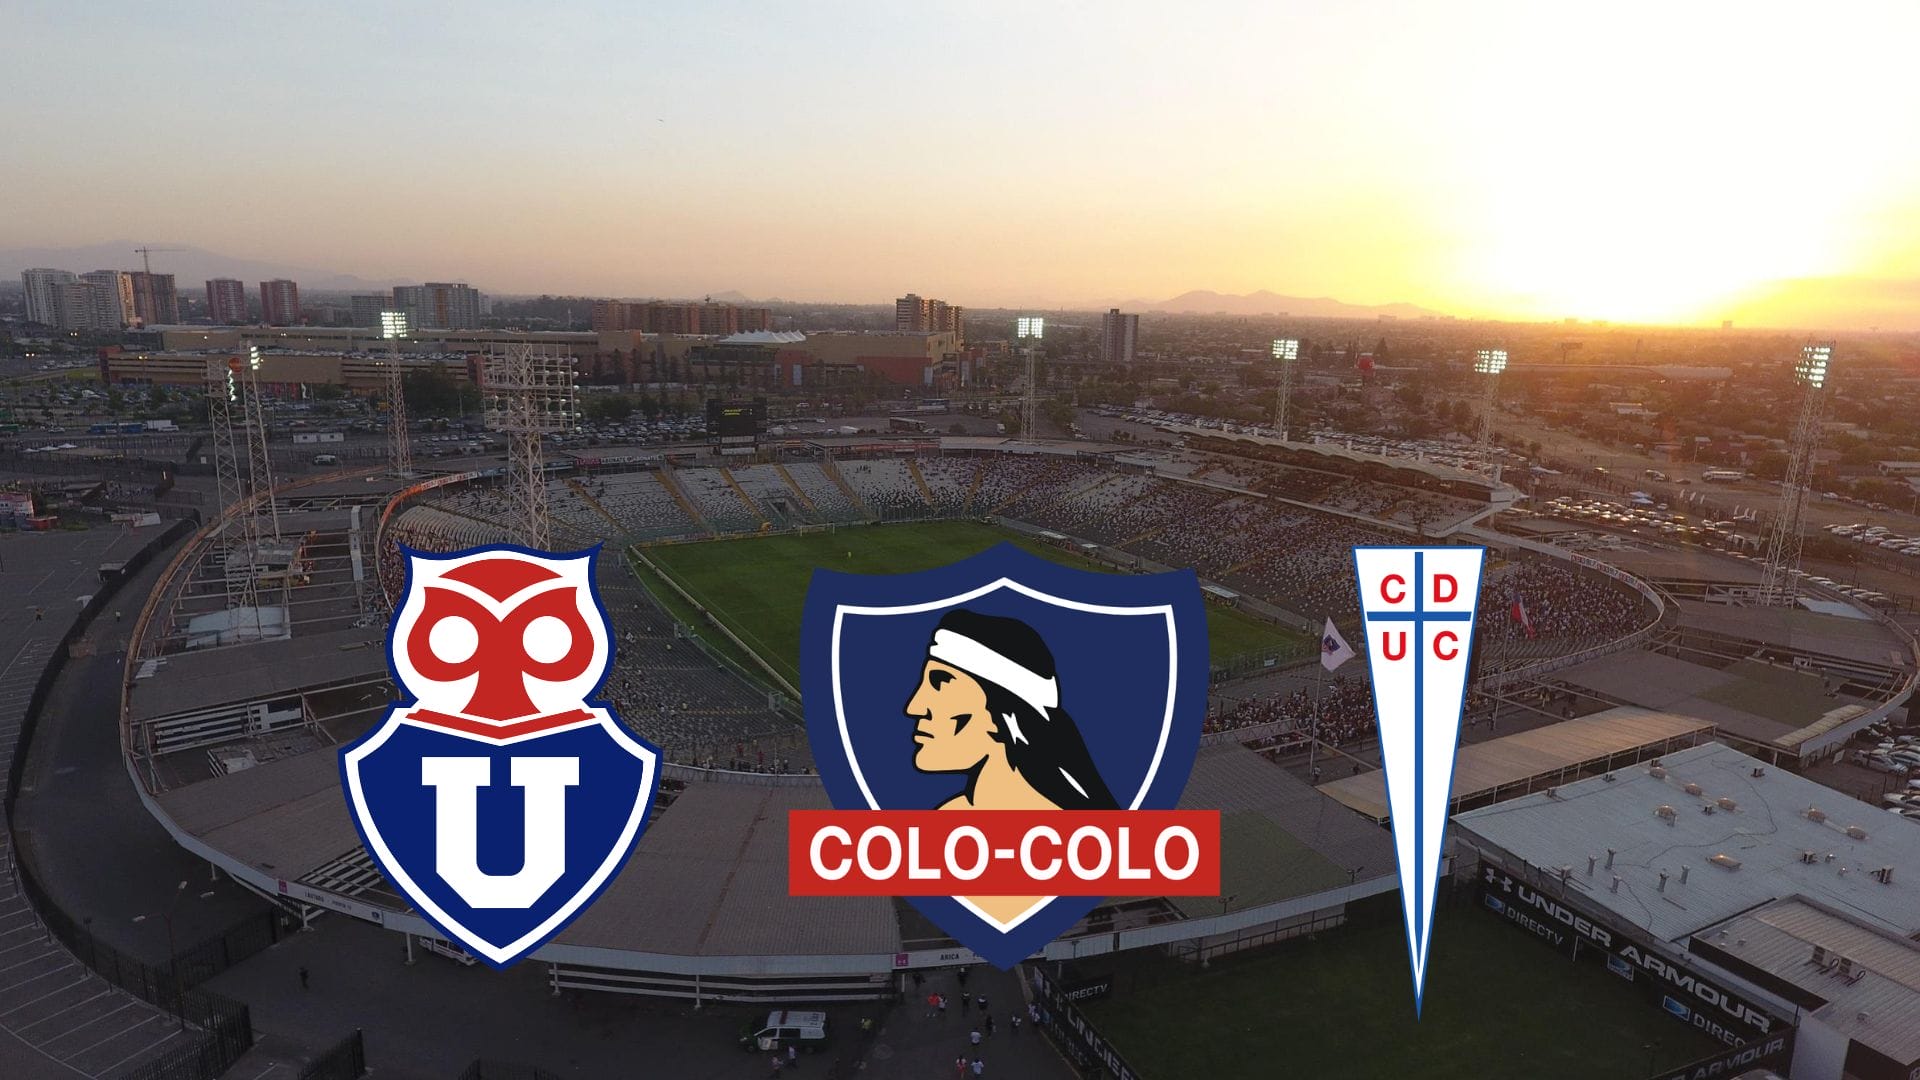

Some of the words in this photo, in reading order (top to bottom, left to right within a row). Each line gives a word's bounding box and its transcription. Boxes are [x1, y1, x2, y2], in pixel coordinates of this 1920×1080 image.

[1506, 906, 1564, 945] DIRECTV
[1518, 885, 1612, 948] UNDER
[1620, 945, 1770, 1035] ARMOUR
[1693, 1012, 1746, 1049] DIREC
